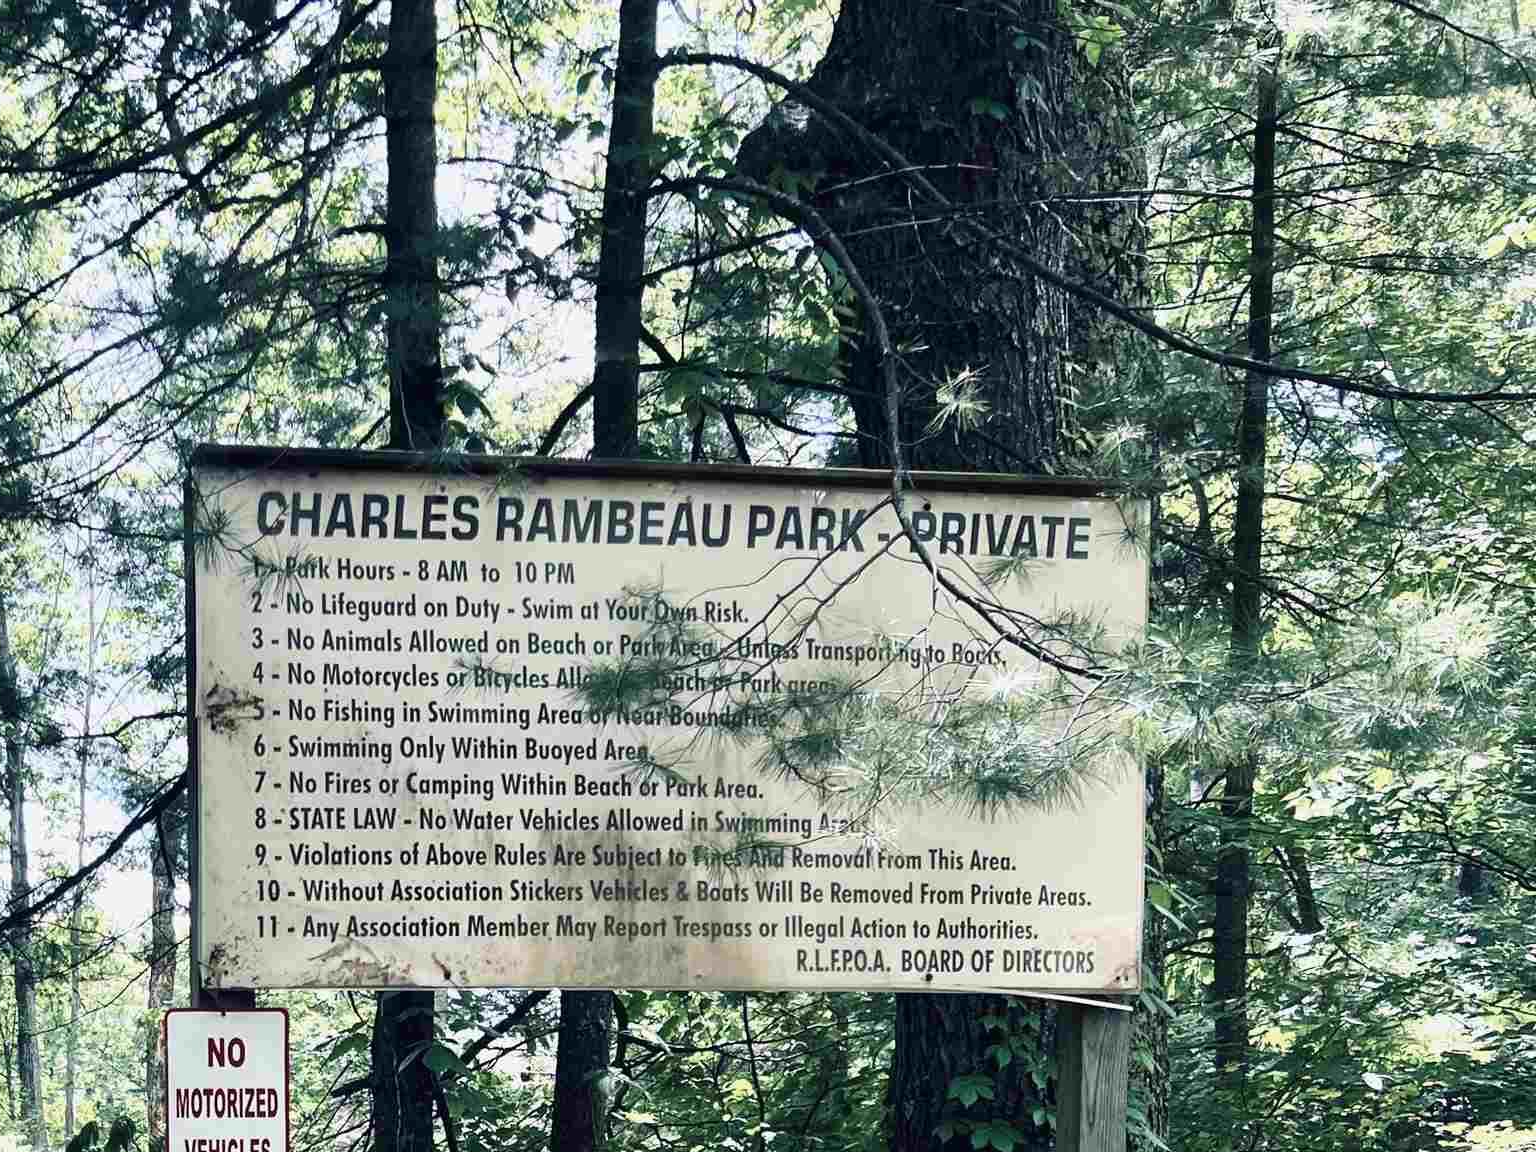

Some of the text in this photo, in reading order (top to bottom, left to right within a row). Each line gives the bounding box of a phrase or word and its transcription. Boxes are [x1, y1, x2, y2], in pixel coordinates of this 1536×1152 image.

[257, 491, 479, 540] CHARLES
[496, 497, 731, 547] RAMBEAU
[747, 505, 866, 552] PARK
[910, 511, 1092, 560] PRIVATE
[287, 556, 330, 578] Park
[338, 558, 395, 580] Hours
[418, 560, 429, 581] 8
[437, 560, 468, 582] AM
[481, 563, 500, 583] to
[516, 562, 536, 583] 10
[545, 562, 575, 584] PM
[252, 592, 263, 613] 2
[287, 592, 314, 614] No
[322, 592, 416, 621] Lifeguard
[424, 601, 448, 617] on
[456, 596, 500, 623] Duty
[523, 597, 573, 620] Swim
[581, 602, 599, 620] at
[606, 599, 648, 621] Your
[655, 600, 697, 621] Own
[705, 601, 749, 623] Risk.
[252, 628, 263, 649] 3
[288, 628, 314, 650] No
[322, 629, 402, 652] Animals
[409, 630, 488, 654] Allowed
[496, 638, 520, 654] on
[528, 632, 586, 655] Beach
[593, 640, 614, 656] or
[620, 634, 663, 657] Park
[928, 643, 945, 663] to
[252, 662, 264, 684] 4
[288, 663, 315, 686] No
[322, 663, 439, 692] Motorcycles
[446, 671, 465, 687] or
[474, 665, 549, 693] Bicycles
[653, 669, 705, 691] each
[741, 672, 781, 694] Park
[288, 699, 315, 721] No
[323, 699, 395, 728] Fishing
[403, 701, 421, 722] in
[428, 701, 530, 729] Swimming
[538, 703, 582, 725] Area
[591, 709, 609, 726] or
[617, 704, 662, 727] Near
[254, 734, 265, 756] 6
[288, 735, 392, 763] Swimming
[400, 736, 445, 763] Only
[452, 737, 517, 759] Within
[526, 738, 597, 765] Buoyed
[255, 771, 266, 793] 7
[289, 771, 316, 793] No
[325, 771, 371, 793] Fires
[379, 778, 399, 794] or
[406, 772, 494, 800] Camping
[502, 773, 565, 795] Within
[574, 774, 632, 797] Beach
[640, 781, 660, 797] or
[667, 775, 708, 798] Park
[714, 777, 764, 799] Area.
[255, 807, 266, 829] 8
[290, 807, 345, 830] STATE
[354, 808, 397, 830] LAW
[420, 808, 446, 830] No
[453, 808, 514, 830] Water
[520, 808, 599, 831] Vehicles
[606, 809, 683, 832] Allowed
[691, 811, 708, 832] in
[715, 811, 812, 839] Swimming
[256, 844, 266, 865] 9
[290, 842, 392, 866] Violations
[400, 842, 419, 866] of
[426, 843, 487, 866] Above
[495, 843, 546, 866] Rules
[554, 844, 585, 867] Are
[593, 845, 661, 871] Subject
[668, 848, 686, 867] to
[792, 847, 871, 869] Removal
[878, 848, 921, 870] From
[929, 849, 964, 871] This
[970, 850, 1016, 872] Area.
[257, 880, 280, 902] 10
[303, 880, 384, 902] Without
[392, 880, 503, 902] Association
[510, 879, 583, 902] Stickers
[590, 880, 668, 903] Vehicles
[676, 881, 688, 903] &
[697, 881, 749, 903] Boats
[756, 881, 793, 903] Will
[801, 882, 823, 903] Be
[831, 882, 913, 904] Removed
[921, 883, 964, 904] From
[972, 884, 1032, 906] Private
[1038, 885, 1092, 906] Areas.
[257, 916, 277, 938] 11
[303, 916, 339, 943] Any
[346, 915, 459, 938] Association
[467, 914, 549, 938] Member
[556, 915, 596, 941] May
[604, 915, 666, 942] Report
[673, 916, 752, 943] Trespass
[759, 922, 778, 938] or
[785, 916, 844, 943] Illegal
[851, 917, 906, 939] Action
[913, 920, 930, 939] to
[937, 917, 1038, 941] Authorities.
[902, 949, 964, 973] BOARD
[971, 950, 994, 973] OF
[1003, 950, 1095, 974] DIRECTORS
[208, 1038, 246, 1068] NO
[176, 1088, 279, 1119] MOTORIZED
